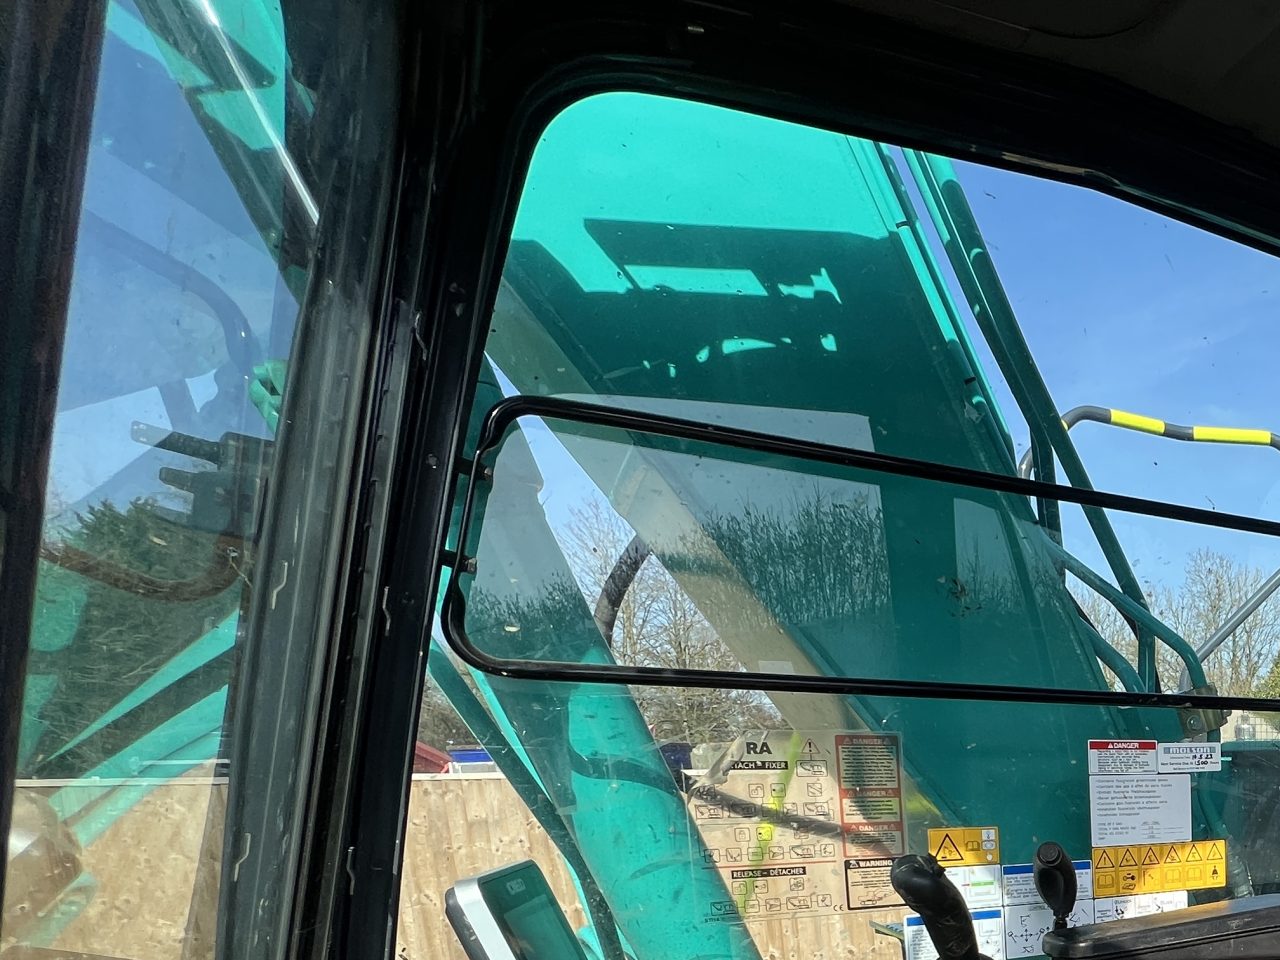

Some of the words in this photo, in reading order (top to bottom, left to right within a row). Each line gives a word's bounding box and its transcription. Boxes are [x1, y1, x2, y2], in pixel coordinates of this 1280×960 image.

[745, 741, 773, 755] RA
[765, 761, 787, 769] FIXER
[858, 860, 893, 868] WARNING
